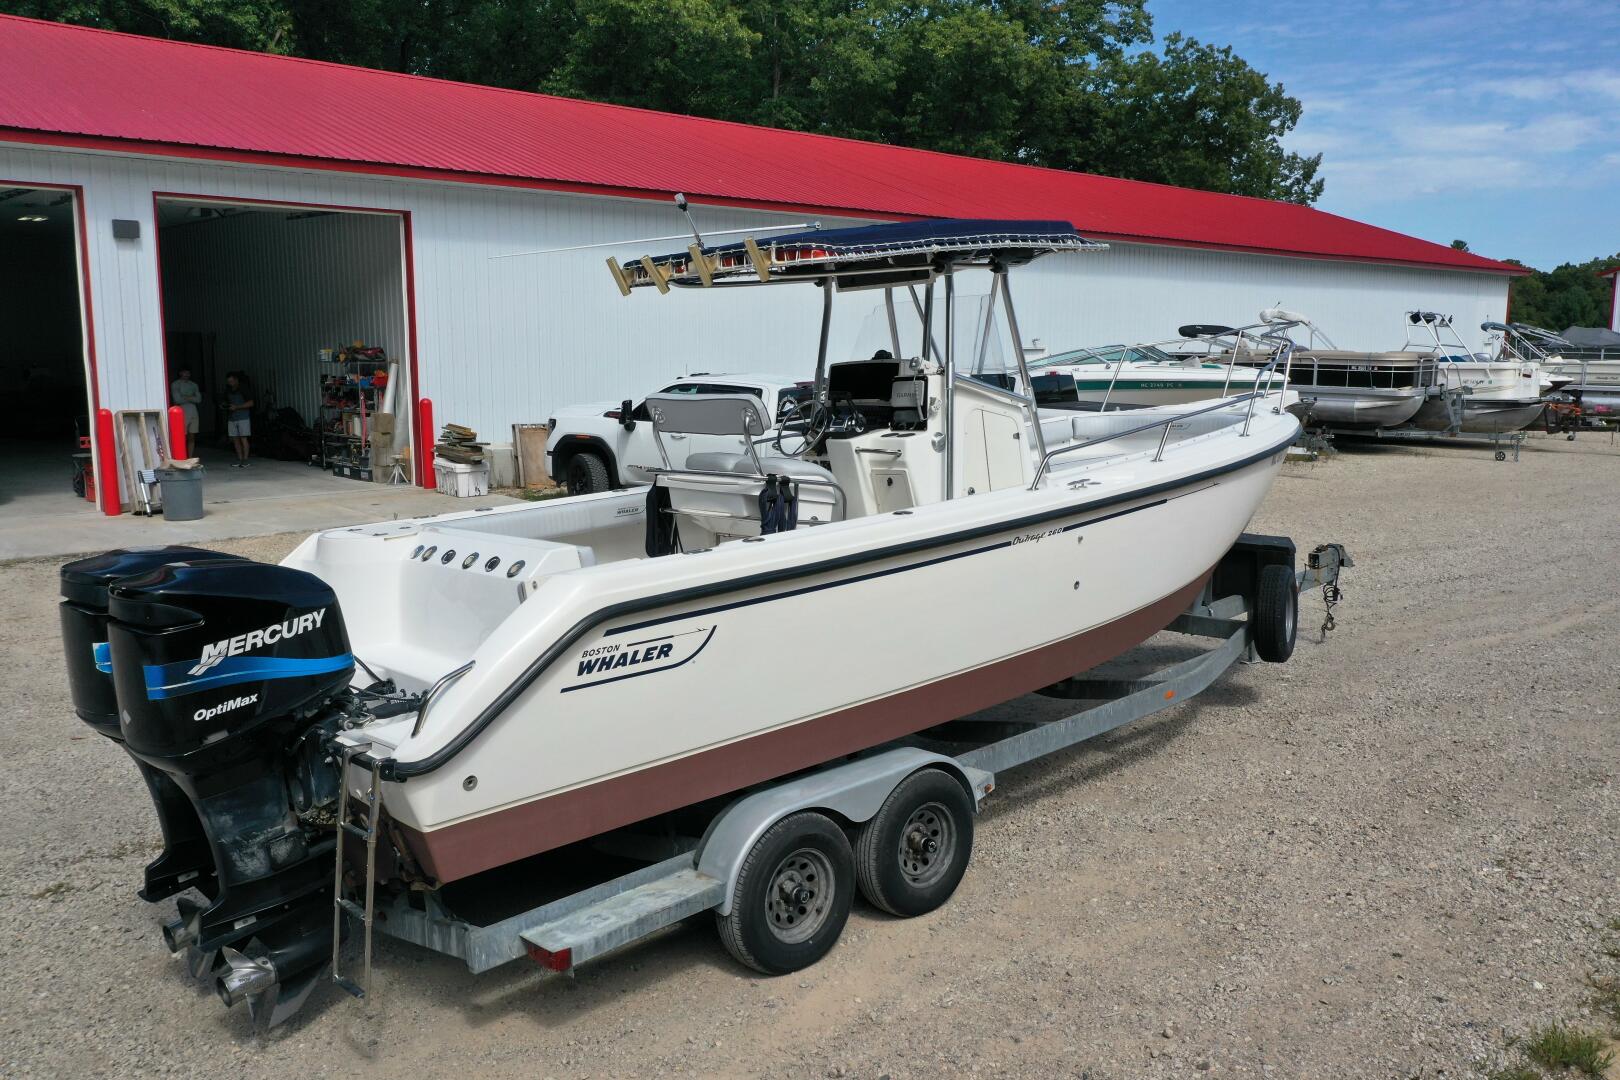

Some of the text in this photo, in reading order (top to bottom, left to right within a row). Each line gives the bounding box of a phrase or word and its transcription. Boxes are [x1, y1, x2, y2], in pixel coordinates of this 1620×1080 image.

[1012, 527, 1063, 546] Outrage 260
[188, 608, 326, 675] MERCURY
[582, 644, 621, 658] BOSTON
[577, 643, 674, 677] WHALER
[193, 693, 259, 721] OptiMax
